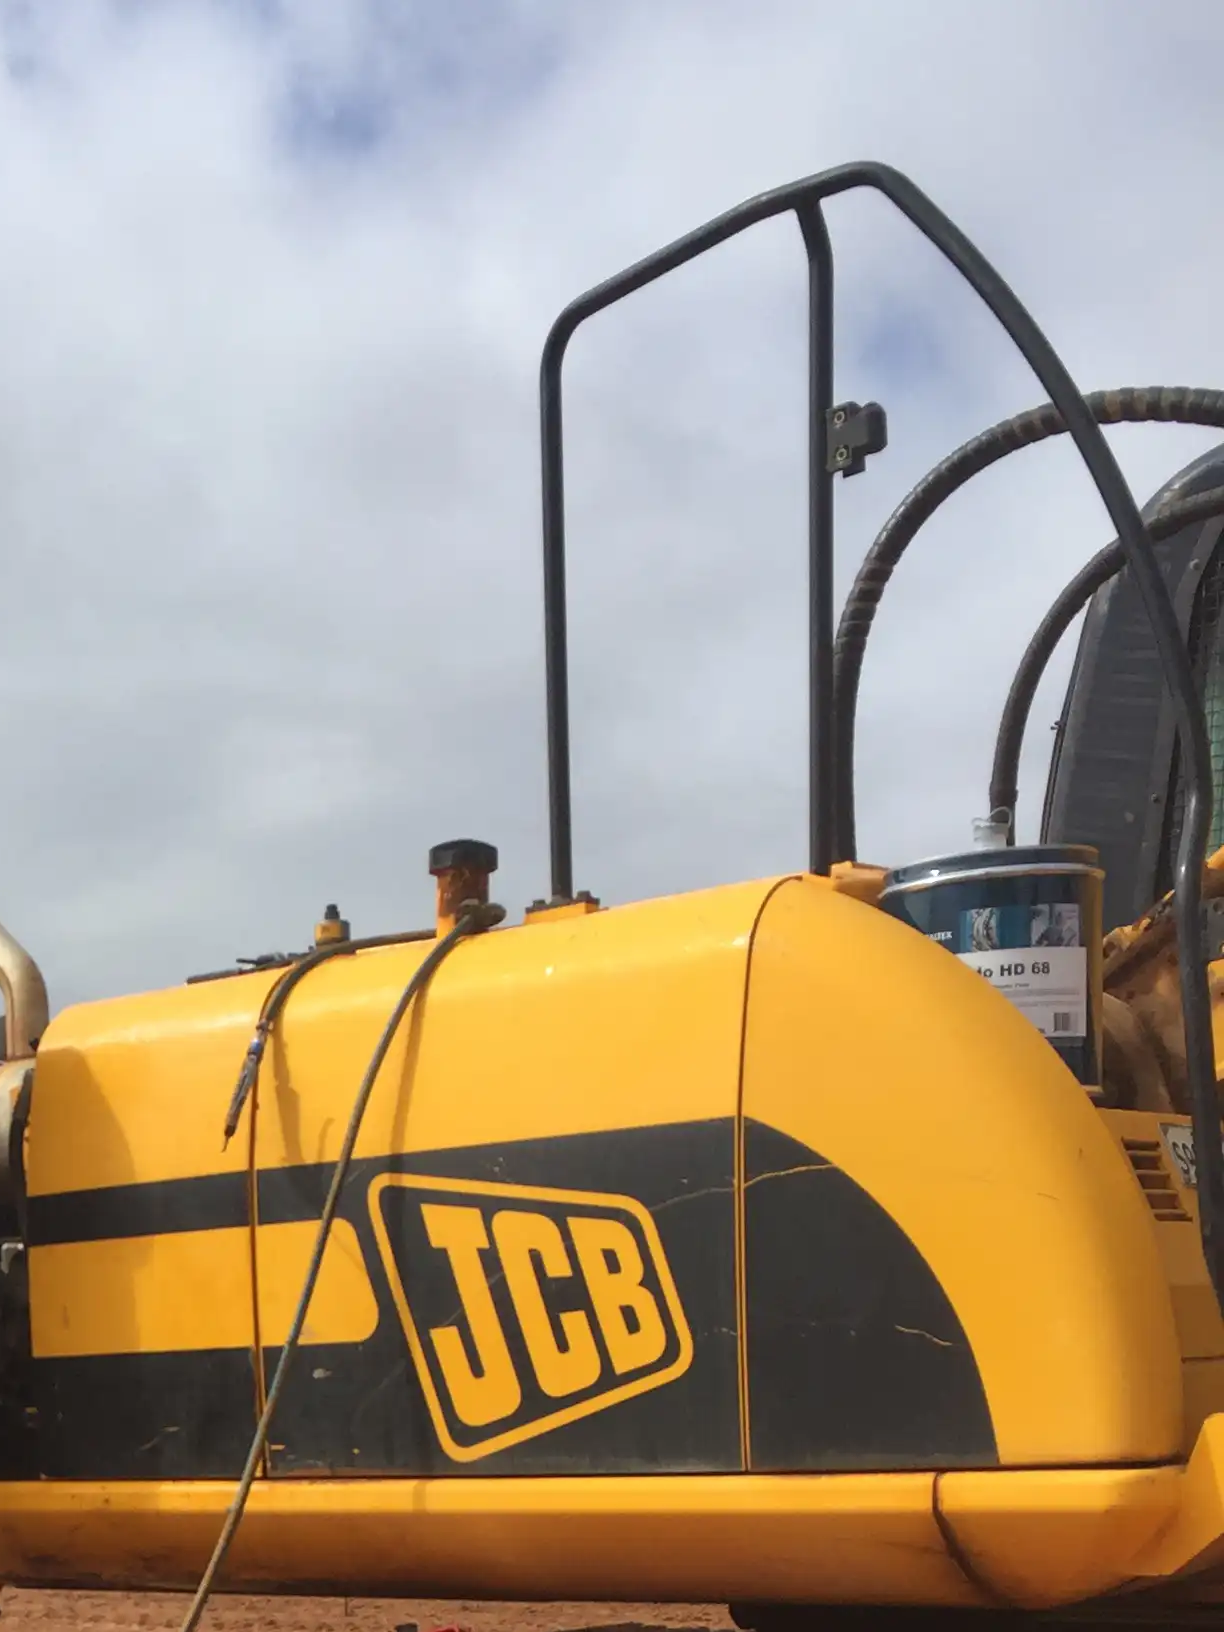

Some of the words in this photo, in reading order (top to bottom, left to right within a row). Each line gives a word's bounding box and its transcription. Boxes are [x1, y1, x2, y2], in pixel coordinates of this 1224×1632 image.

[1000, 963, 1025, 977] HD
[1032, 961, 1051, 975] 68
[420, 1203, 667, 1427] JCB
